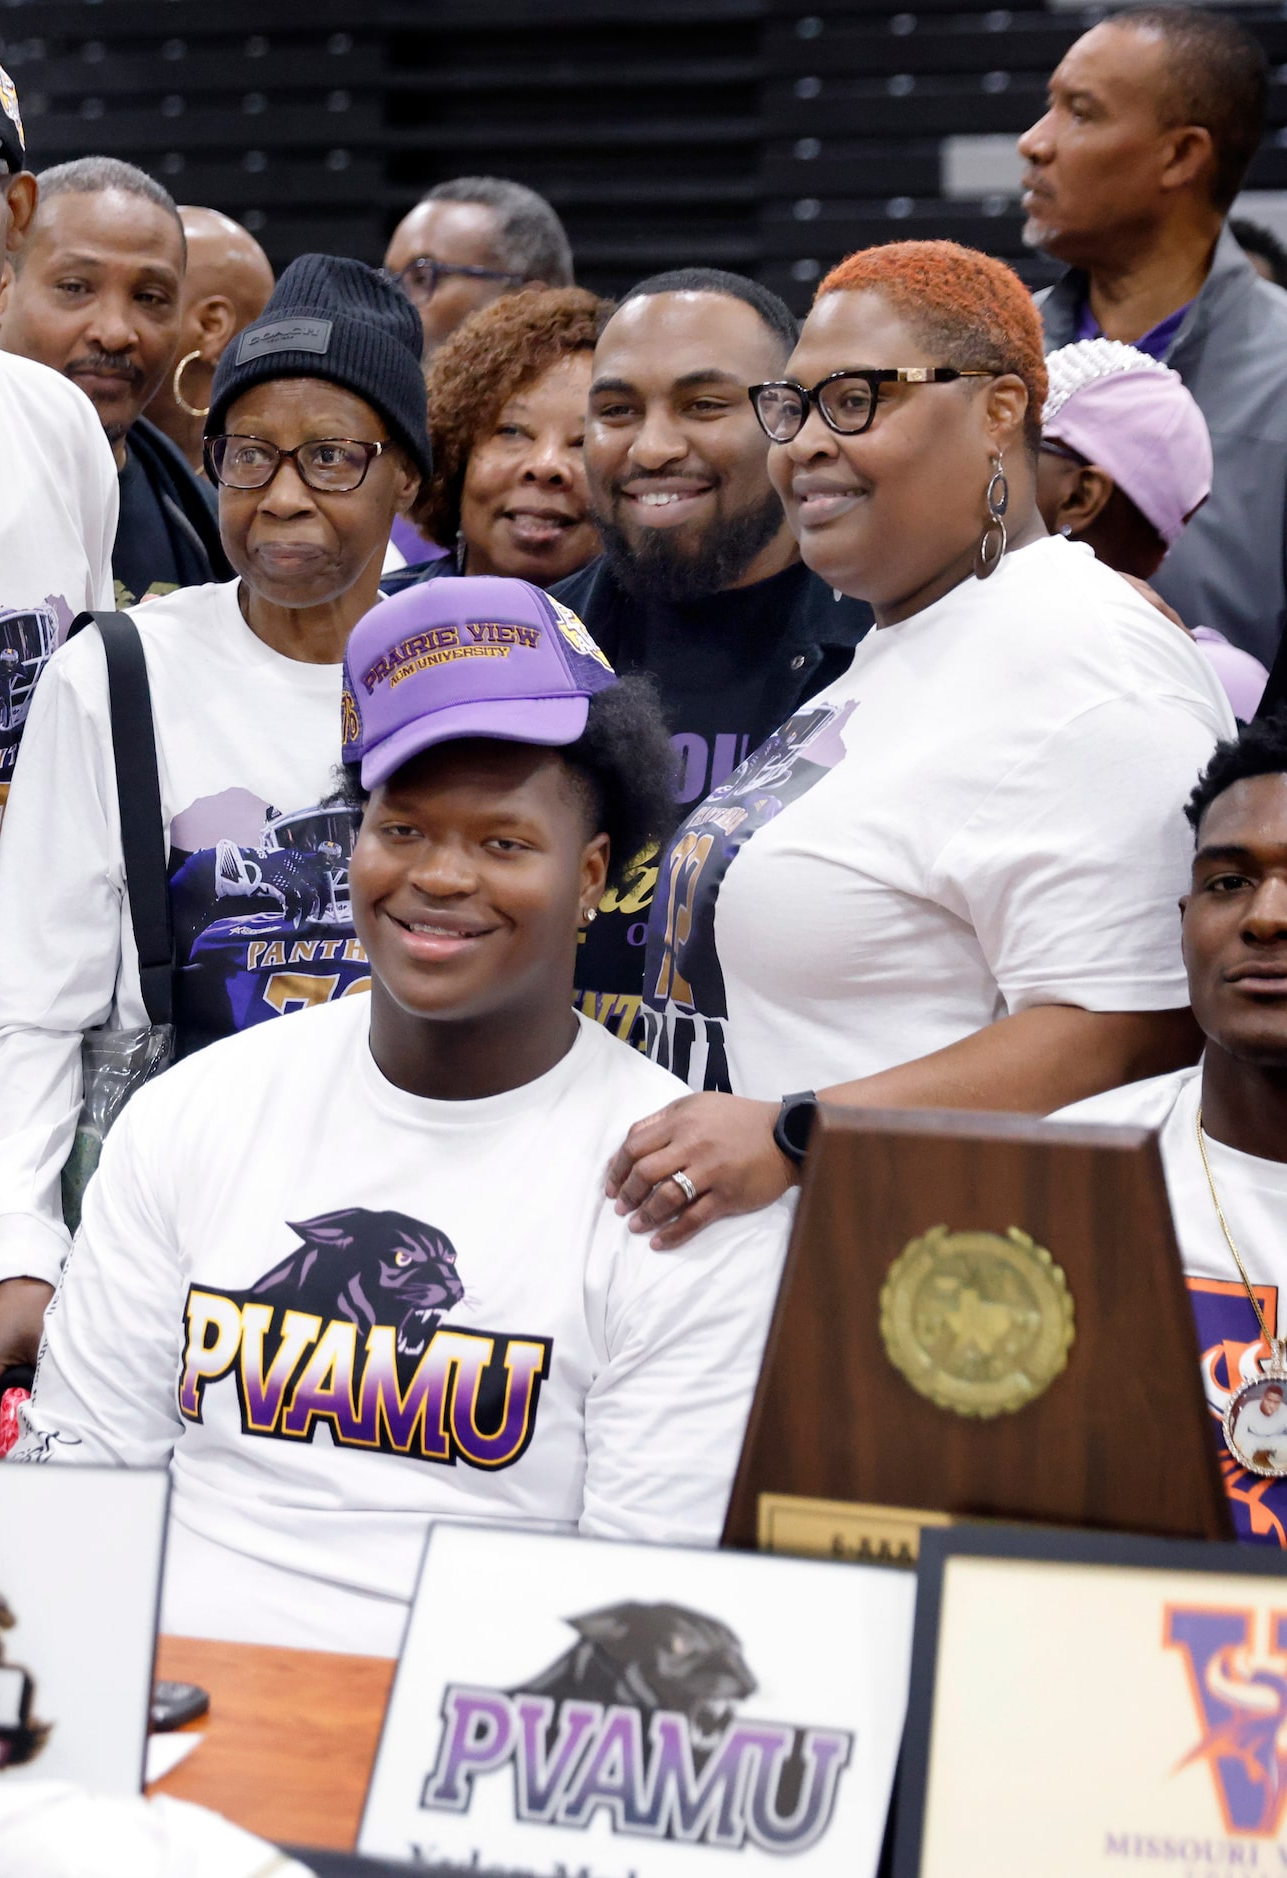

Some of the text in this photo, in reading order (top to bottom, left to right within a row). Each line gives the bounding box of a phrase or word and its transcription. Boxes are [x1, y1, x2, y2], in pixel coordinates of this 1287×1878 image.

[362, 626, 460, 696] PRAIRIE
[465, 623, 541, 649] VIEW
[417, 646, 511, 671] UNIVERSITY
[179, 1289, 546, 1465] PVAMU
[420, 1684, 856, 1854] PVAMU
[1105, 1834, 1260, 1867] MISSOURI
